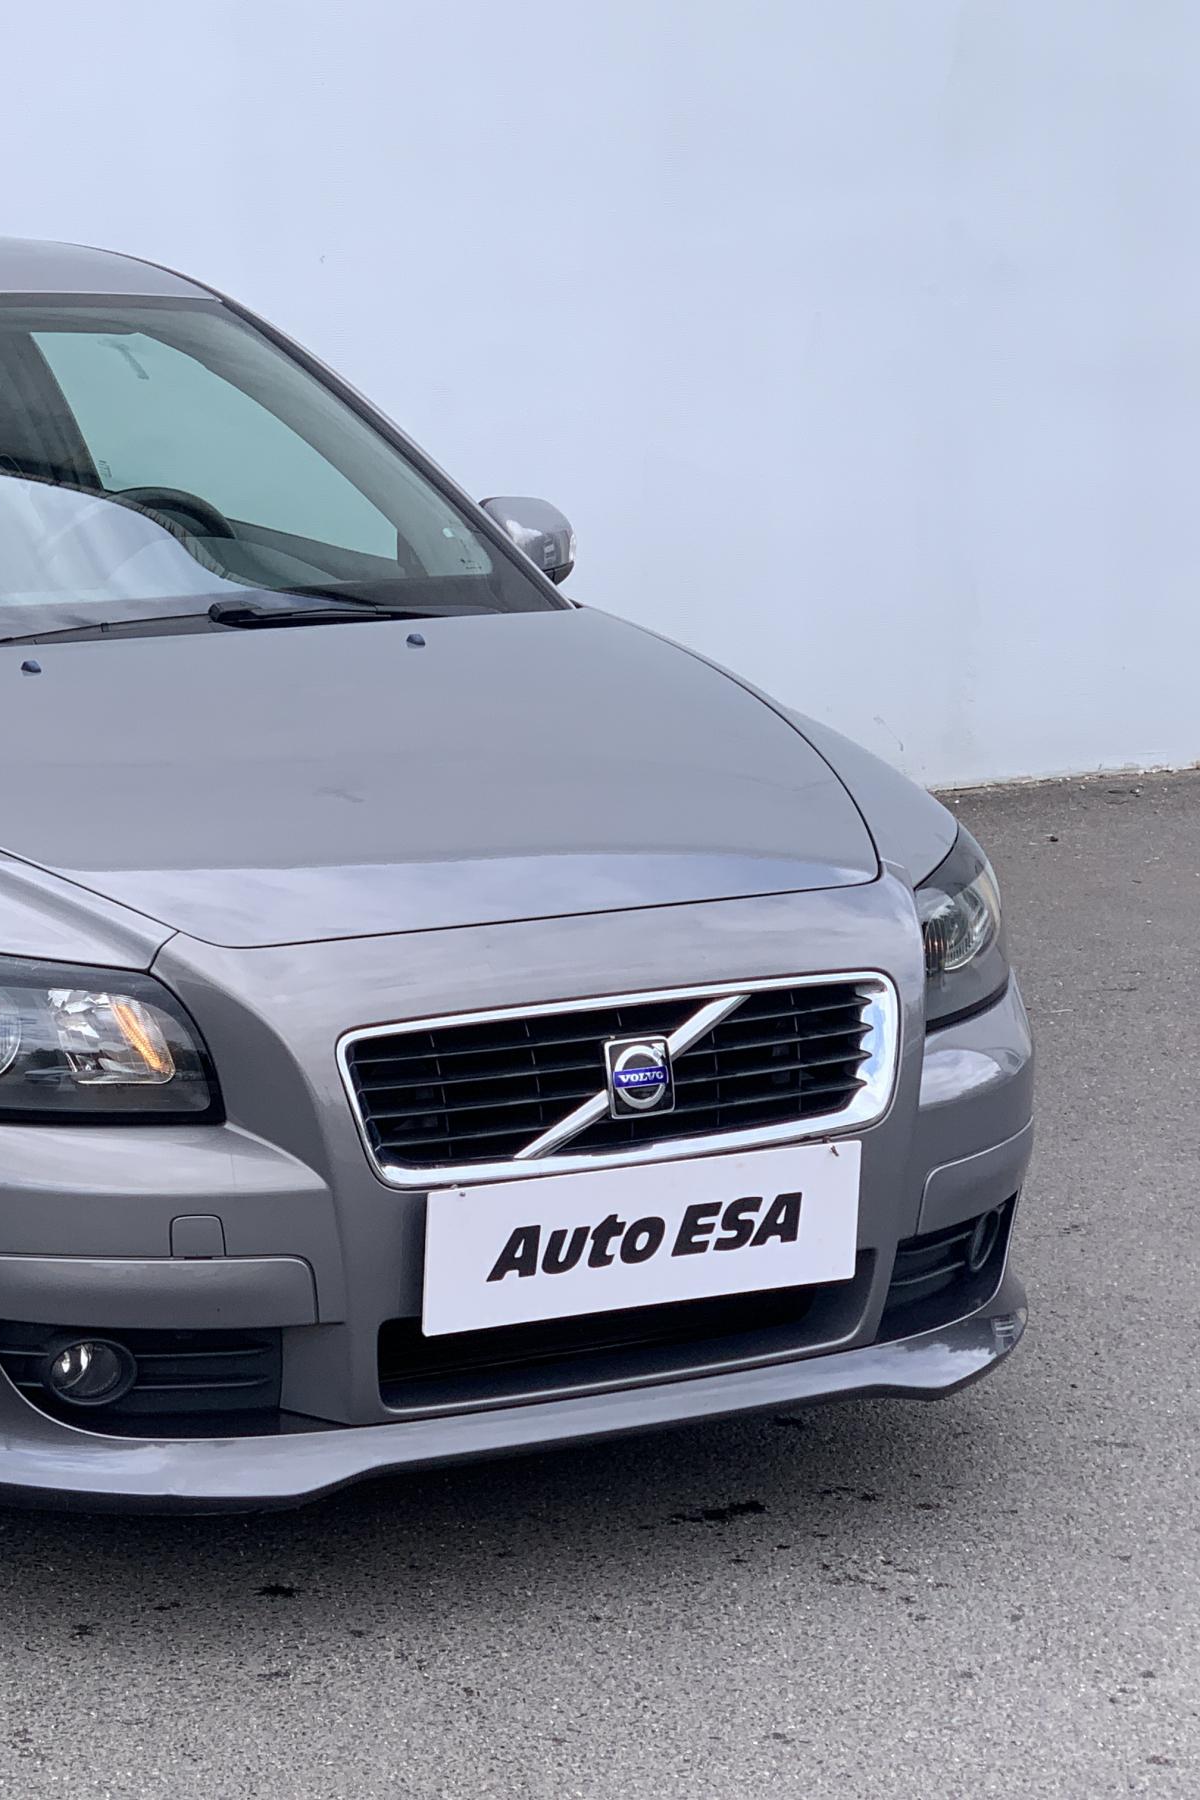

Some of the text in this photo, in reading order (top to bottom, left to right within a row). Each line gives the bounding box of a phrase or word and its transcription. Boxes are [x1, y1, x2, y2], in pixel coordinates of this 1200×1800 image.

[617, 1071, 664, 1083] VOLVO
[486, 1192, 802, 1282] Auto ESA
